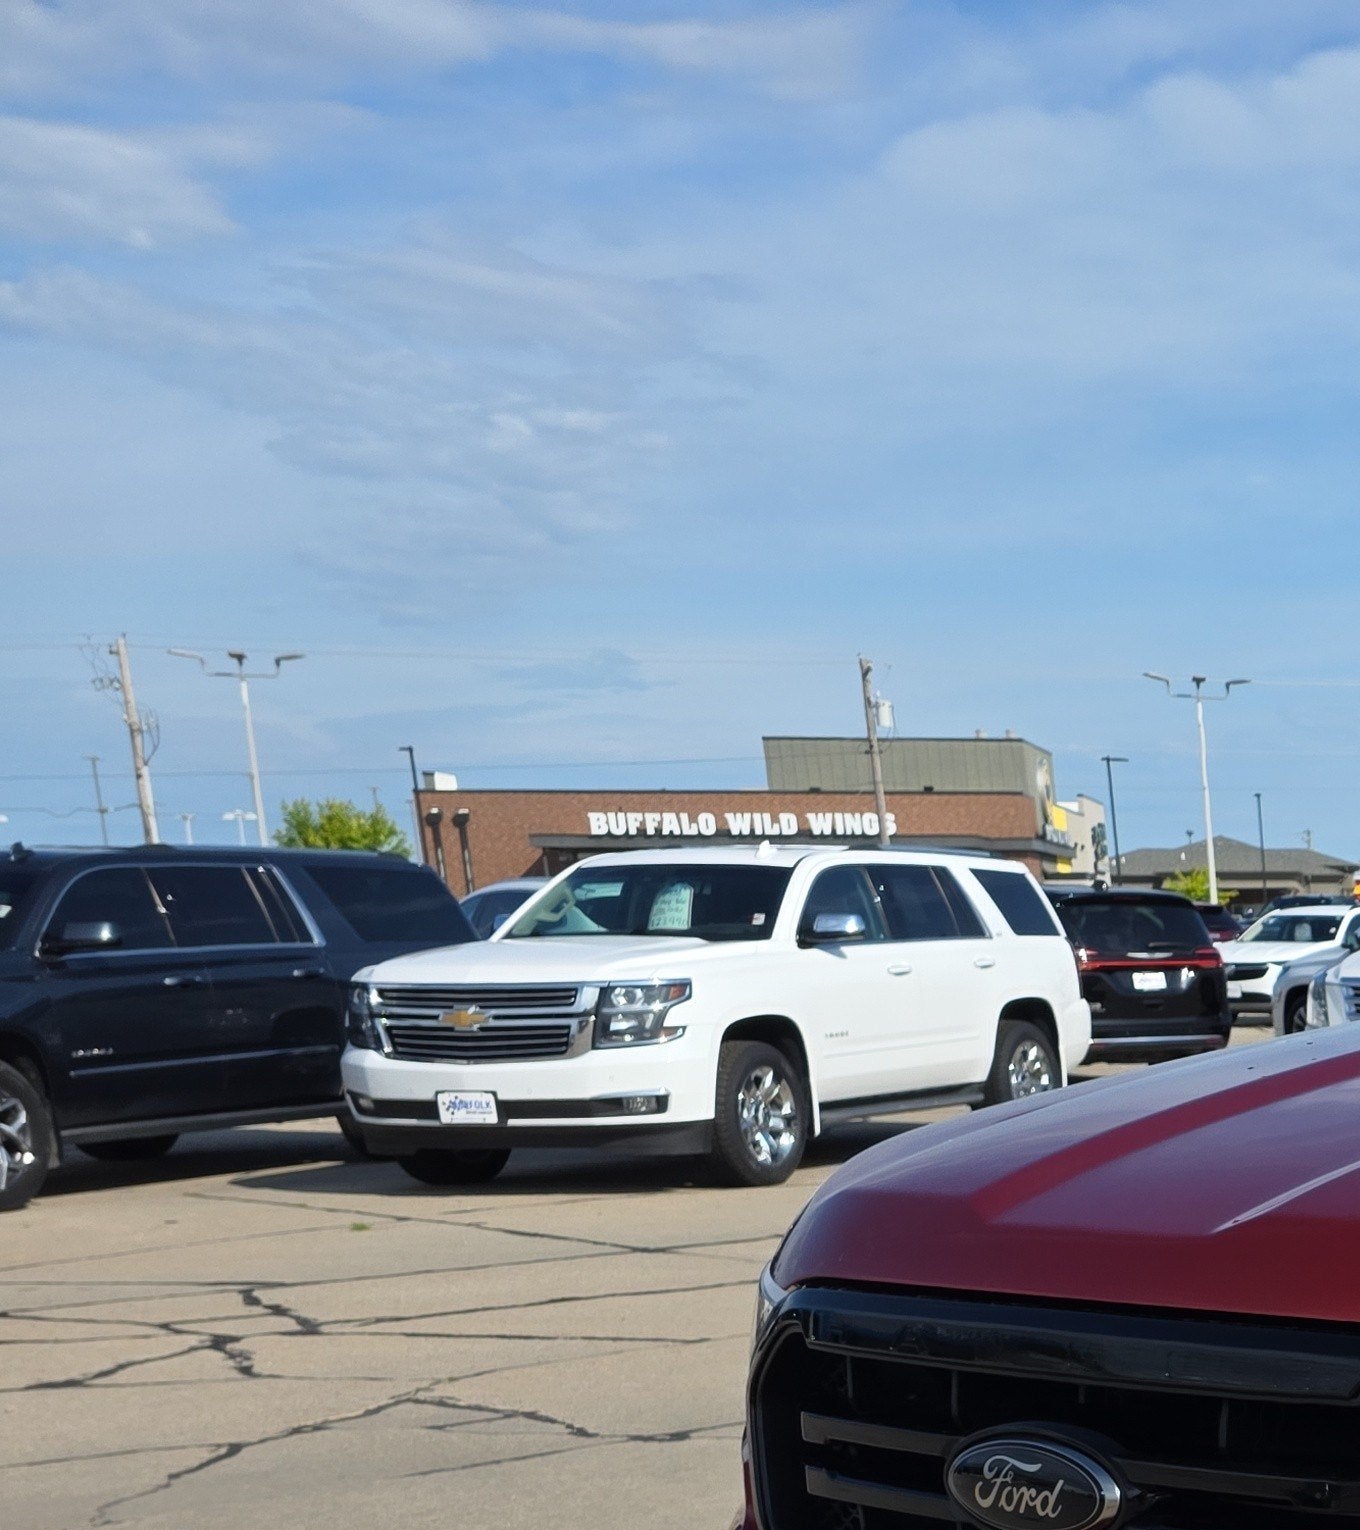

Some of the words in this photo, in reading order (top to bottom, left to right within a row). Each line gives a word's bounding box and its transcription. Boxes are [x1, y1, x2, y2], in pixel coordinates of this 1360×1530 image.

[588, 812, 716, 836] BUFFALO
[724, 812, 799, 836] WILD
[806, 812, 898, 836] WINGS
[974, 1455, 1064, 1519] Ford
